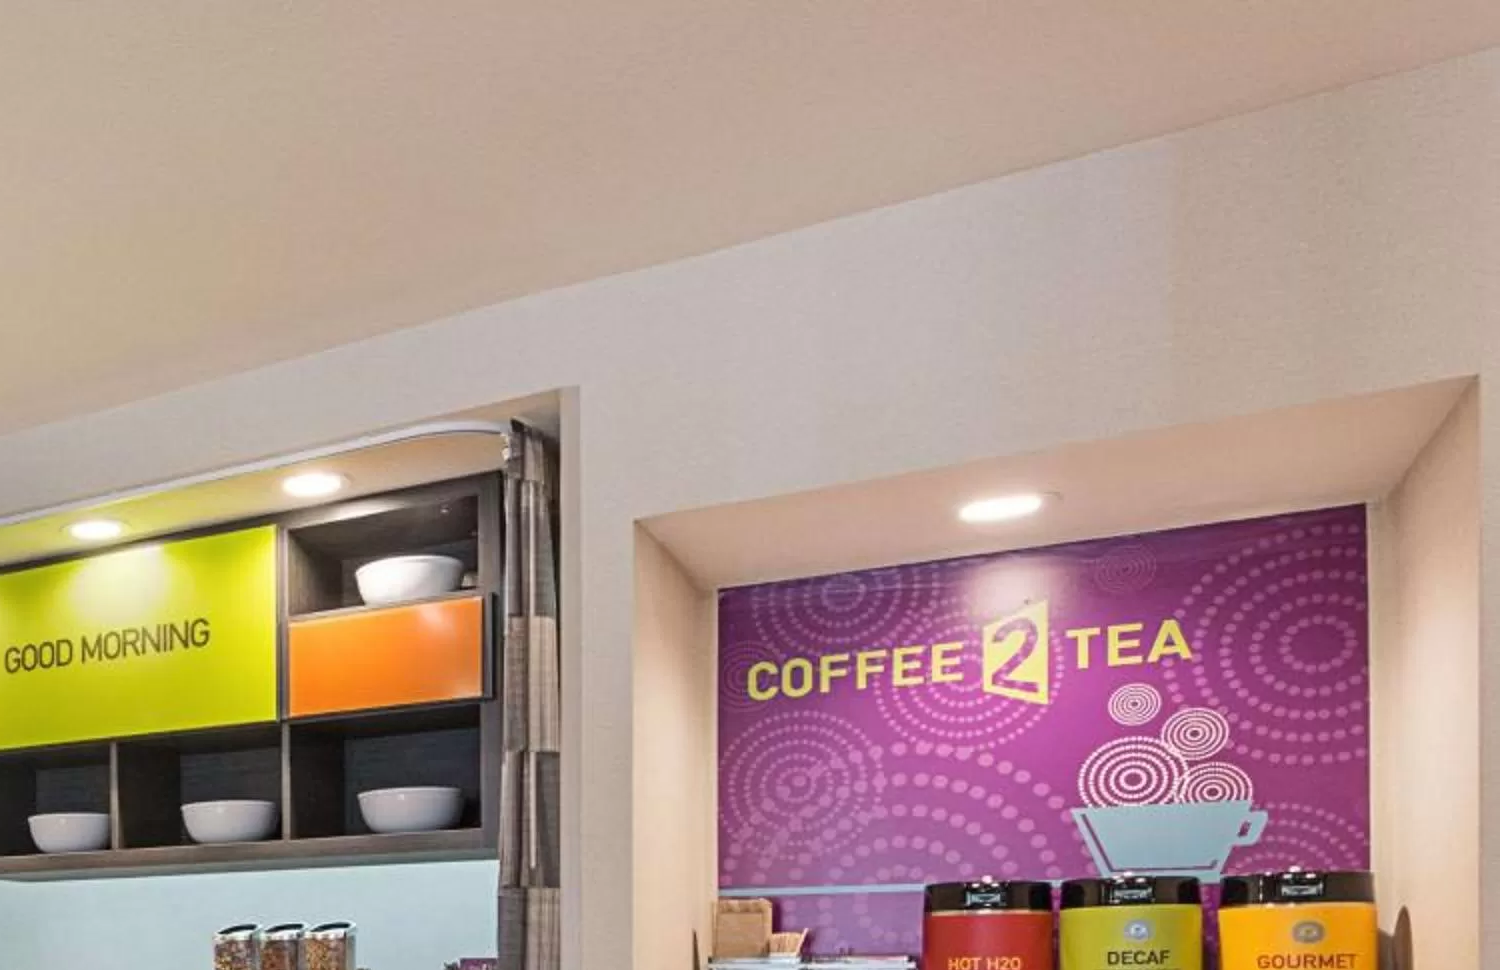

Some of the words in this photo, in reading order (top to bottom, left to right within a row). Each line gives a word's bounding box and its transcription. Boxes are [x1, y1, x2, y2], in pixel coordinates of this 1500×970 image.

[3, 638, 74, 674] GOOD
[80, 617, 211, 665] MORNING
[746, 640, 965, 702] COFFEE
[989, 614, 1041, 695] 2
[1065, 618, 1193, 670] TEA
[1106, 949, 1171, 966] DECAF
[1256, 952, 1357, 970] GOURMET
